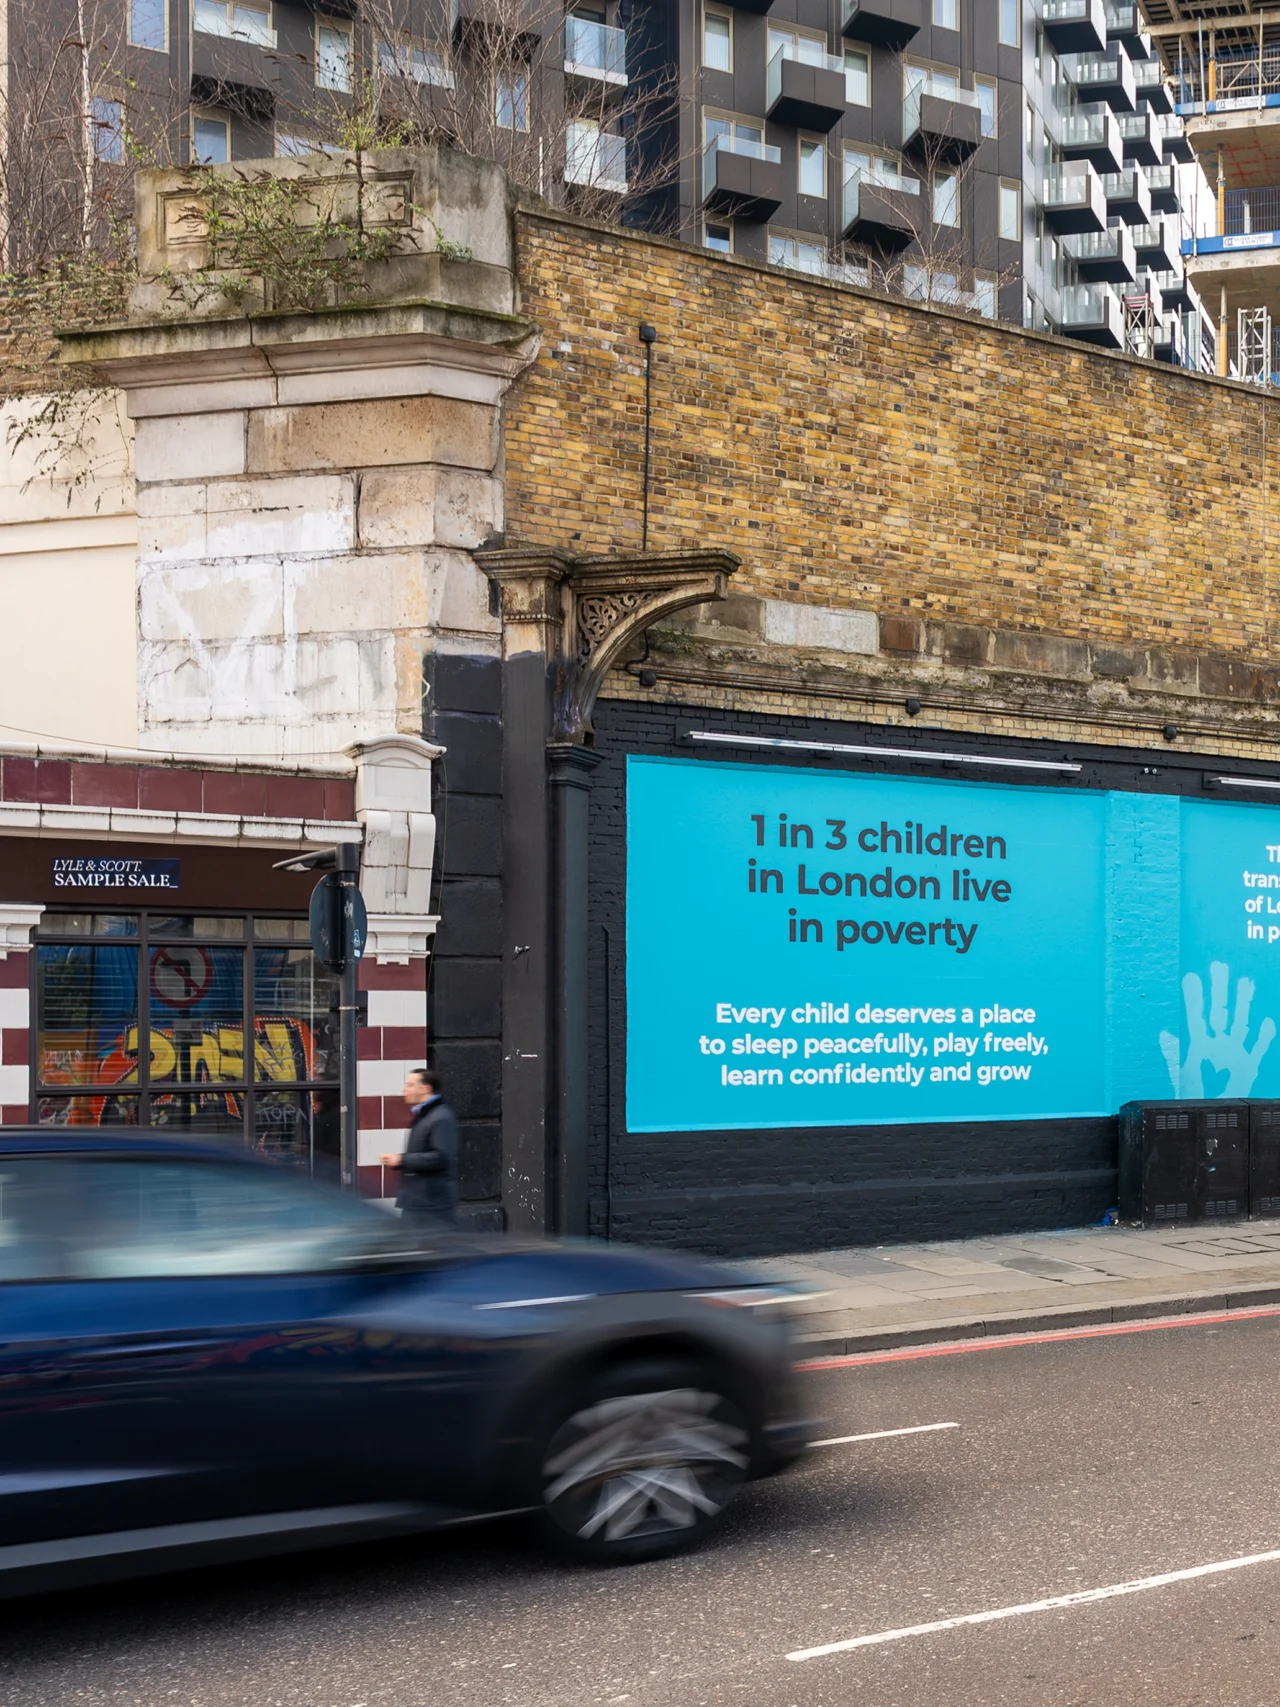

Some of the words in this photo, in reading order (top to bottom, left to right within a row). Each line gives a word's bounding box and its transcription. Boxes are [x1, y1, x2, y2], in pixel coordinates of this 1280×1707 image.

[751, 815, 764, 846] 1
[779, 813, 813, 848] in
[825, 820, 847, 850] 3
[858, 821, 1006, 859] children
[54, 860, 84, 871] LYLE
[86, 860, 96, 871] &
[98, 861, 141, 871] SCOTT.
[55, 873, 124, 886] SAMPLE
[748, 858, 783, 893] in
[798, 864, 940, 899] London
[953, 869, 1011, 902] live
[1245, 895, 1264, 913] of
[789, 908, 822, 942] in
[837, 918, 978, 954] poverty
[1247, 920, 1264, 940] in
[716, 1003, 786, 1028] Every
[791, 1002, 849, 1023] child
[855, 1003, 956, 1023] deserves
[961, 1008, 973, 1023] a
[980, 1004, 1036, 1027] place
[699, 1036, 726, 1054] to
[732, 1034, 798, 1059] sleep
[805, 1033, 928, 1058] peacefully,
[934, 1032, 979, 1057] play
[984, 1032, 1048, 1055] freely,
[722, 1065, 783, 1085] learn
[790, 1062, 925, 1086] confidently
[930, 1062, 971, 1081] and
[977, 1066, 1031, 1085] grow
